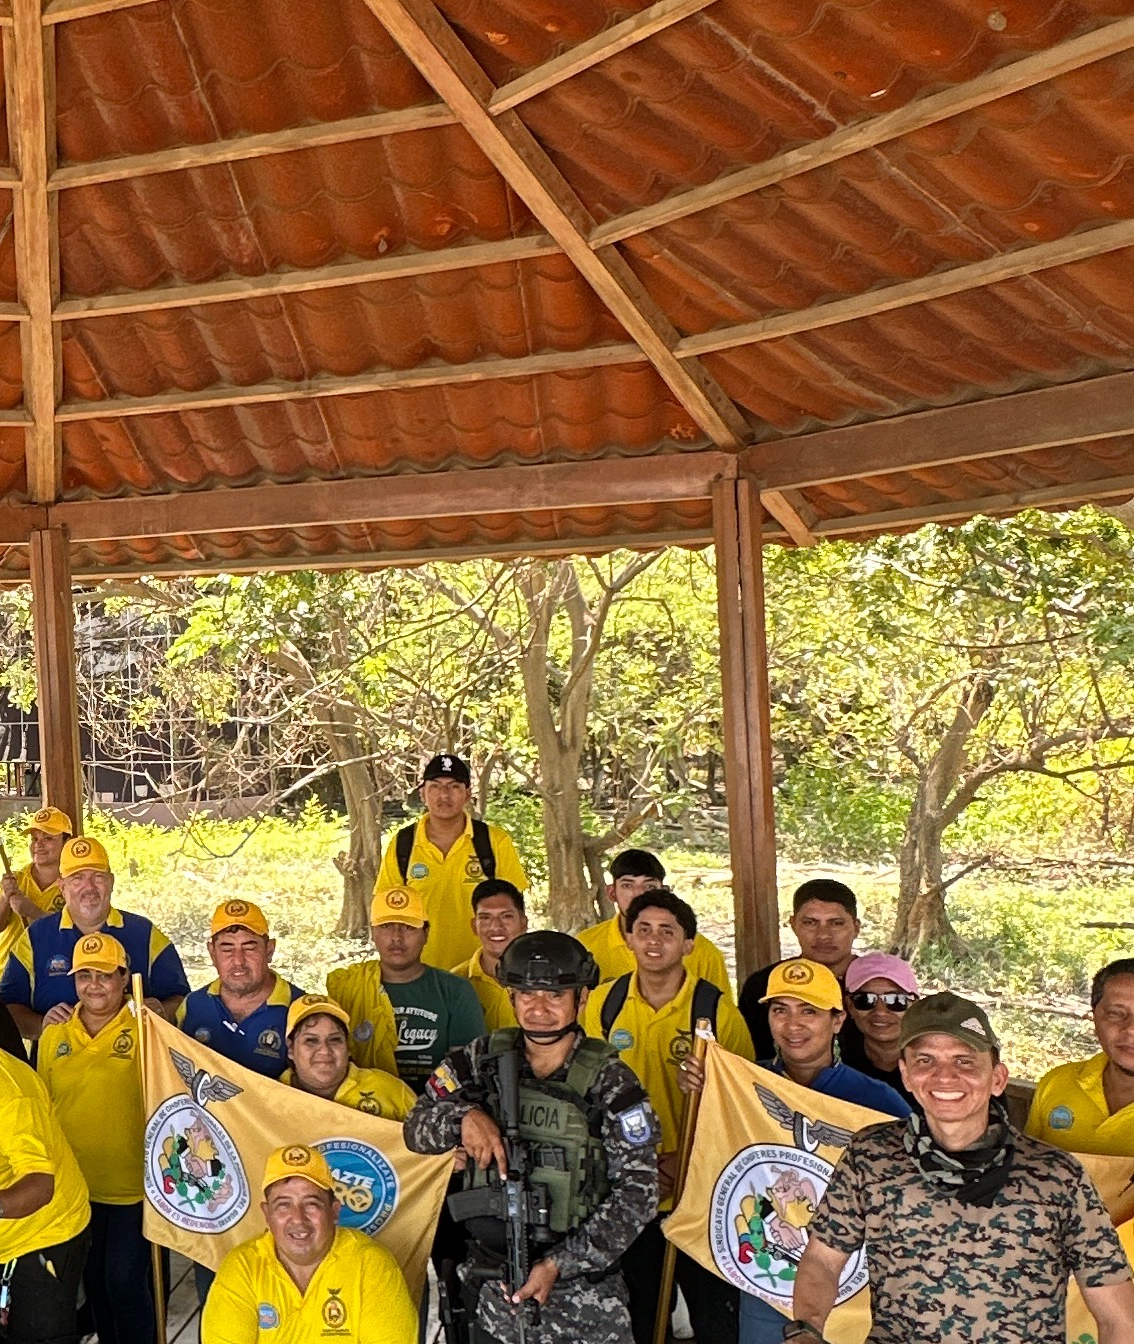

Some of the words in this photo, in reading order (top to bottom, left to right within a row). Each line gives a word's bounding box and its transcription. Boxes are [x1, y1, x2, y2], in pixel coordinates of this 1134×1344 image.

[398, 1020, 438, 1044] Legacy
[521, 1105, 561, 1130] LICIA
[317, 1142, 395, 1188] OFESIONALIZATE
[779, 1151, 830, 1176] PROFESION
[329, 1167, 376, 1189] AZTE
[716, 1171, 738, 1208] GENERAL
[715, 1209, 726, 1254] SINDICATO
